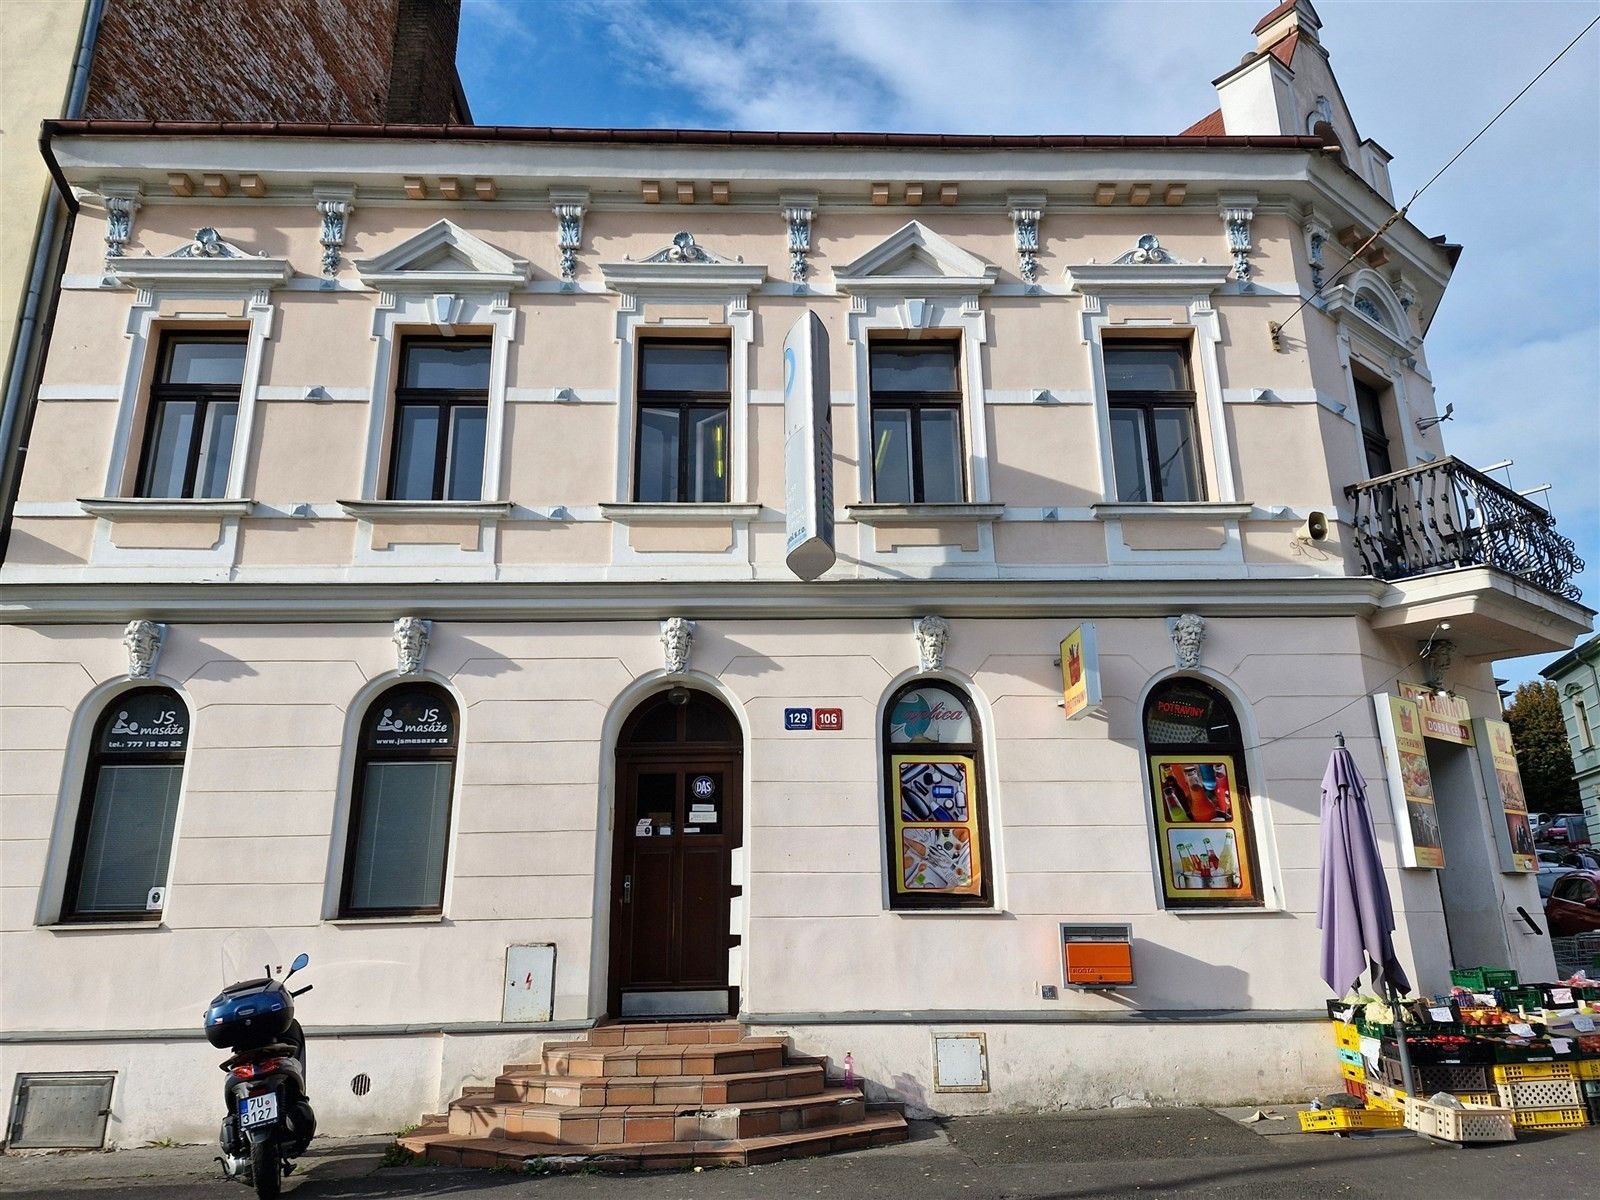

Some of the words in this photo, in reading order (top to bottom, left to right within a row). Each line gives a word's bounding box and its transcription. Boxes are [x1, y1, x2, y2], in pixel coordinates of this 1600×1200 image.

[418, 708, 439, 722] JS
[1157, 701, 1205, 717] POTRAVINY
[153, 711, 176, 724] JS
[789, 713, 807, 723] 129
[819, 713, 837, 724] 106
[140, 724, 184, 735] masáže
[404, 721, 447, 733] masáže
[250, 1097, 264, 1110] 7U
[243, 1107, 271, 1125] 3127
